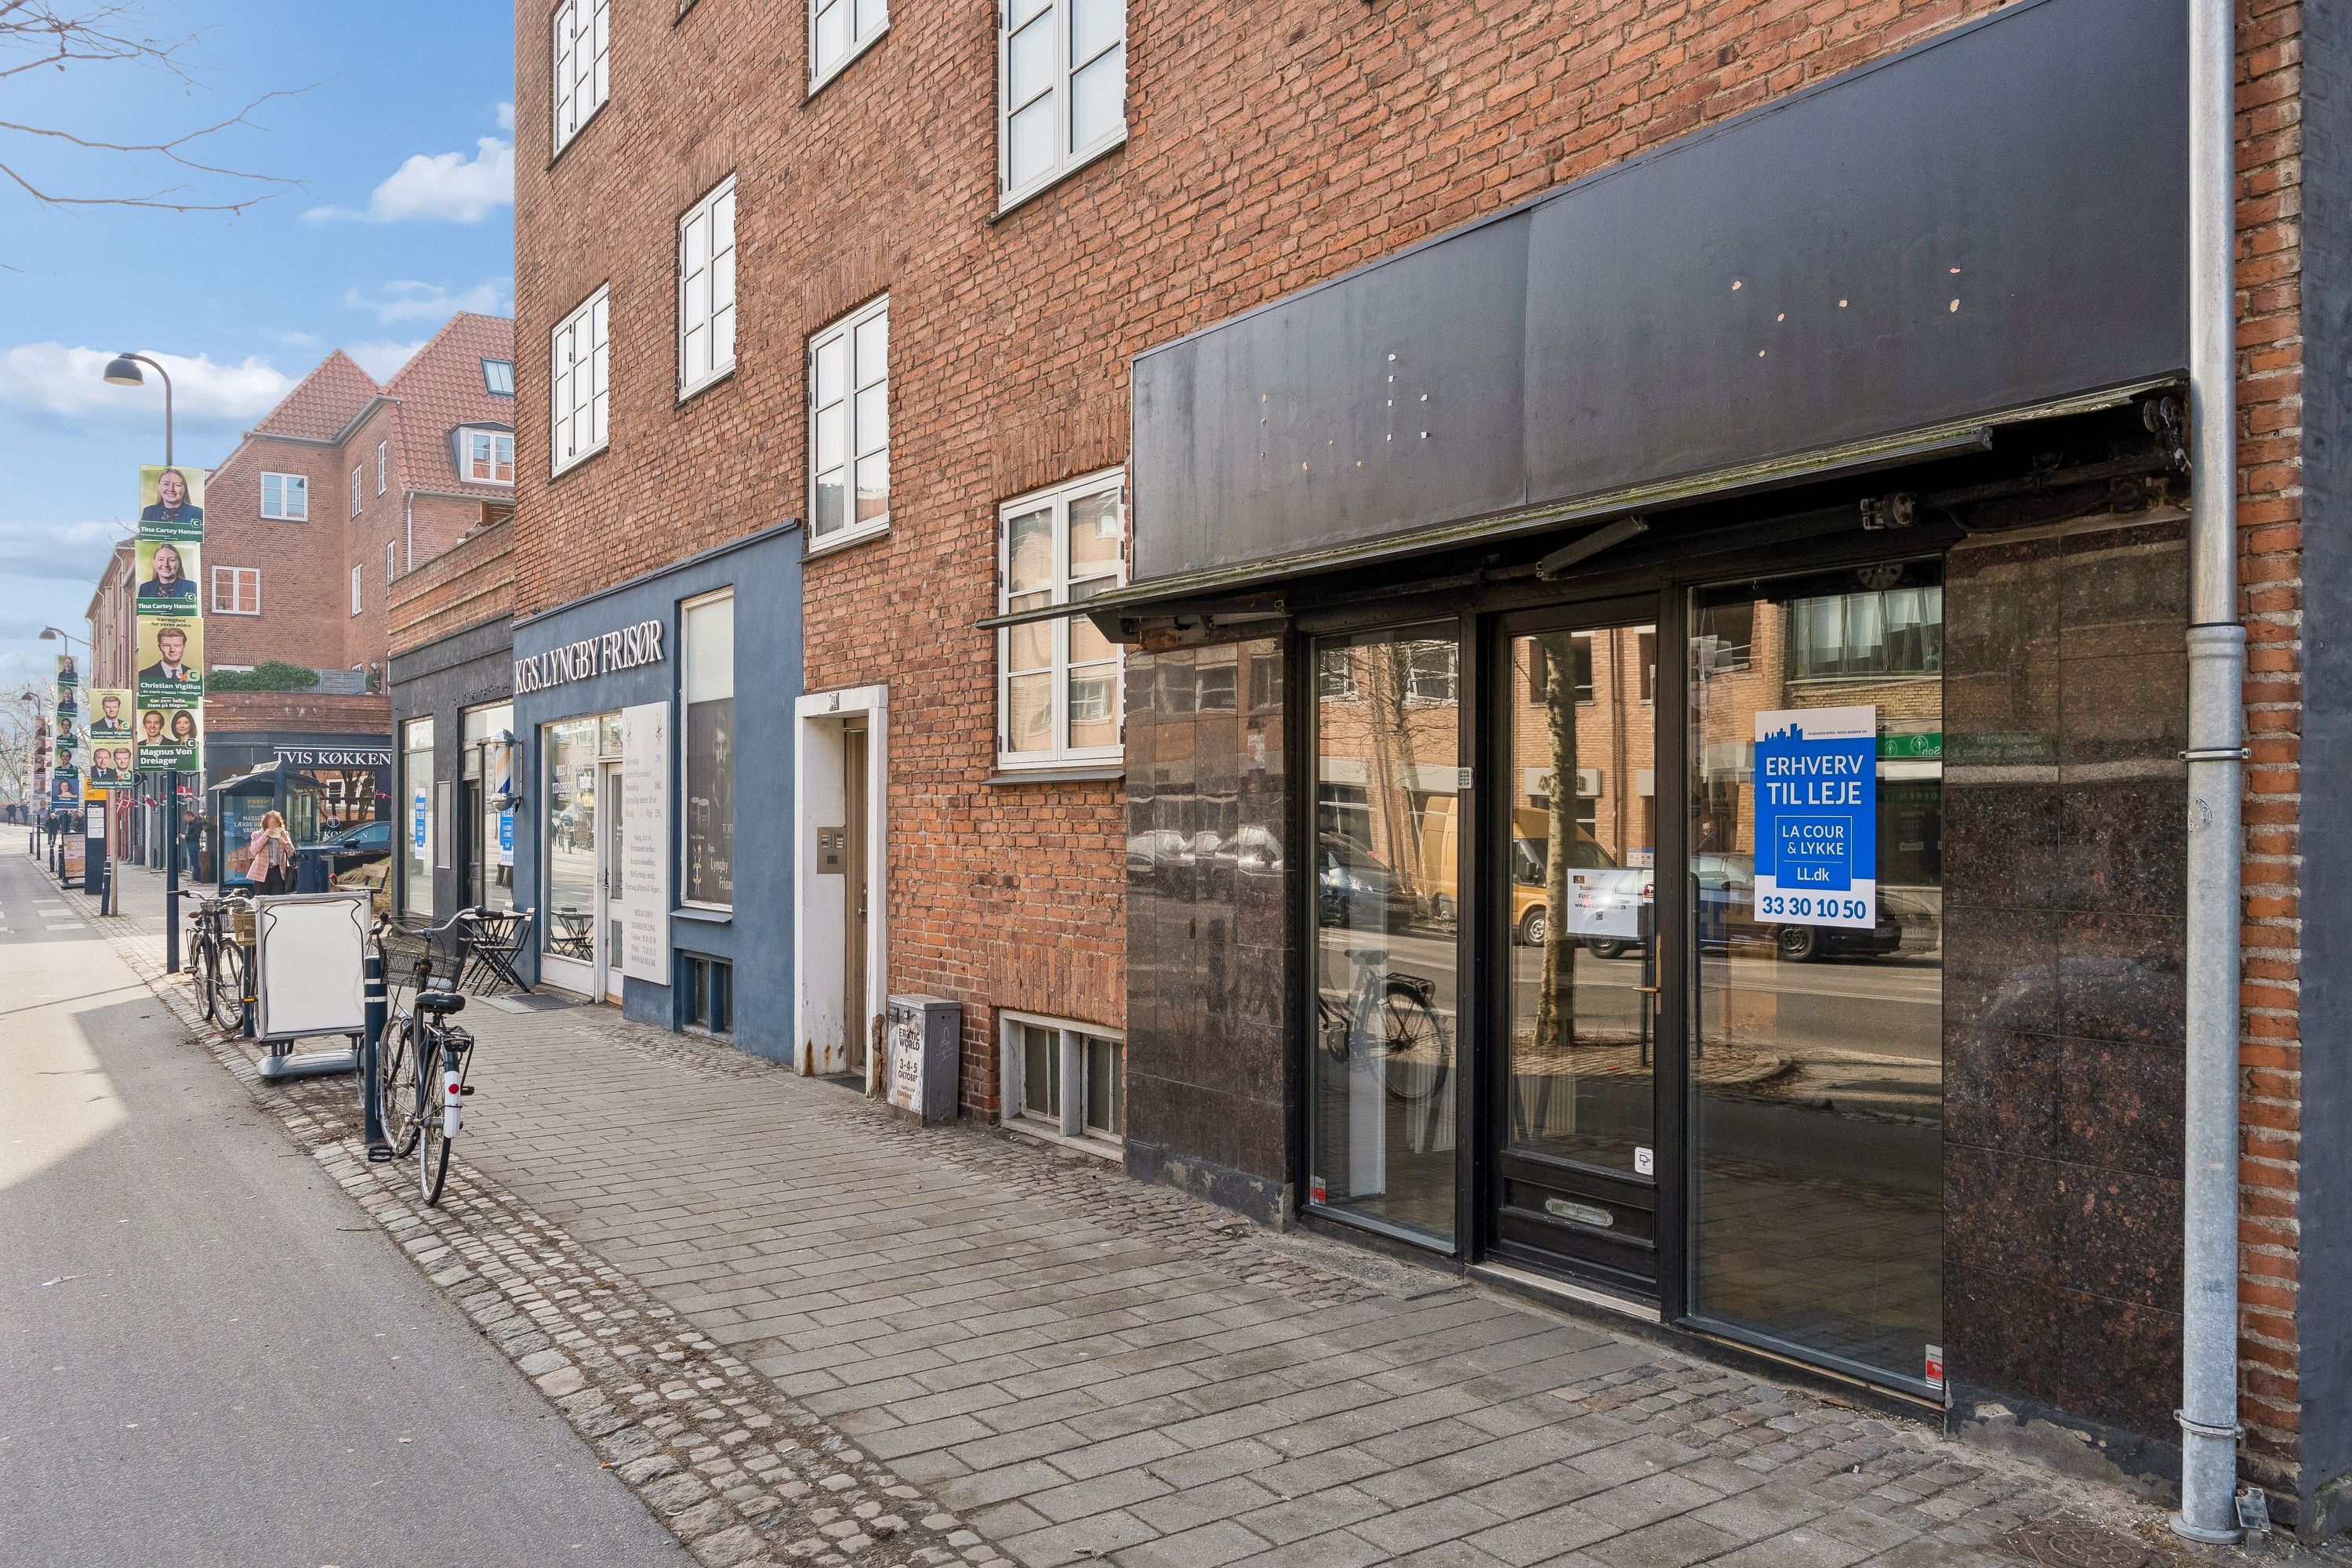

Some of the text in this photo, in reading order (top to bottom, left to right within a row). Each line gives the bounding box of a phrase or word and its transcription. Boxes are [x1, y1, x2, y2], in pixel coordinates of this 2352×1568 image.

[515, 619, 664, 695] KGS. LYNGBY FRISØR
[140, 749, 174, 757] Magnus
[274, 751, 392, 765] TVIS KØKKEN
[140, 757, 177, 766] Dreiager
[1766, 755, 1864, 776] ERHVERV
[1766, 781, 1862, 804] TIL LEJE
[1783, 825, 1844, 839] LA COUR
[1788, 842, 1844, 855] & LYKKE
[710, 857, 728, 874] Lyngby
[1797, 867, 1830, 882] LL.dk
[1762, 895, 1866, 920] 33 30 10 50
[898, 1036, 920, 1051] WORLD
[899, 1058, 917, 1073] 3-4-5
